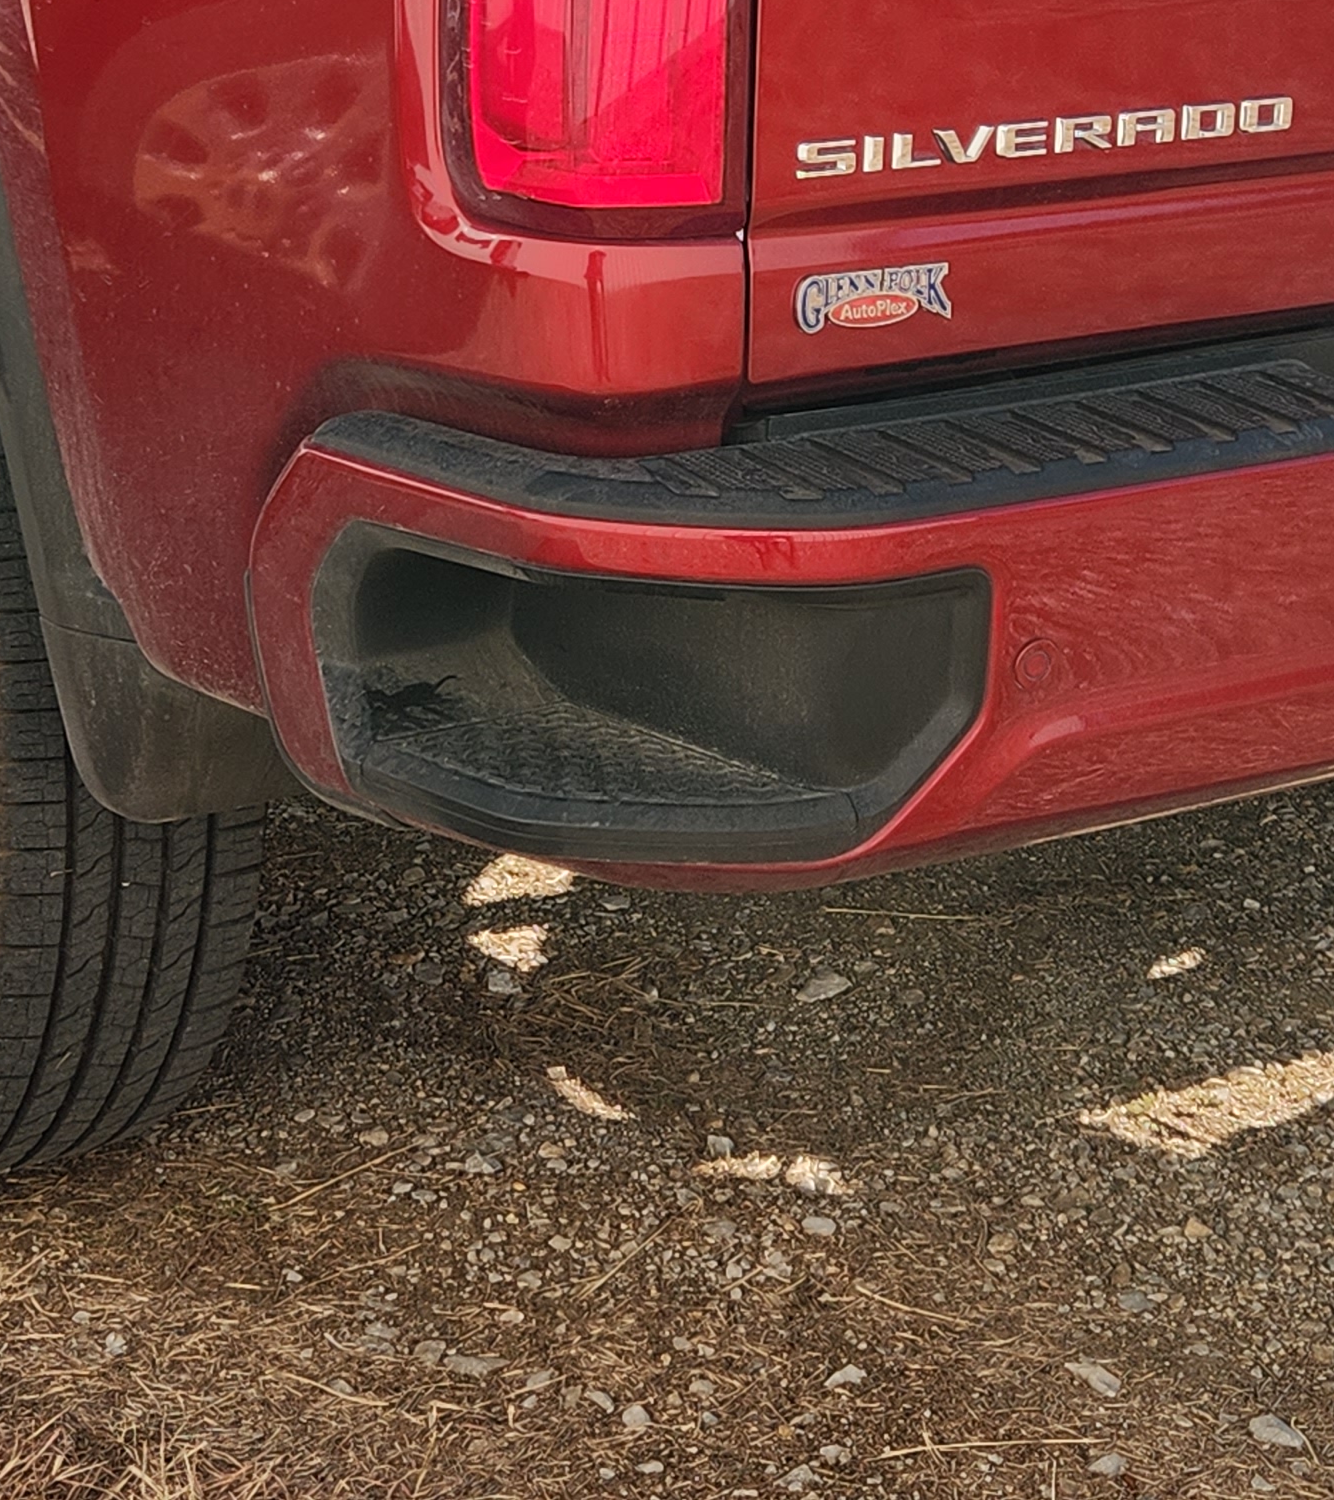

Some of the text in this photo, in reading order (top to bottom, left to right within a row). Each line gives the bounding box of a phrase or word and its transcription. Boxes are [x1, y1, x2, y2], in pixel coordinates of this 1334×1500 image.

[795, 96, 1294, 180] SILVERADO
[798, 270, 882, 332] GLENN
[839, 298, 909, 321] AutoPlex
